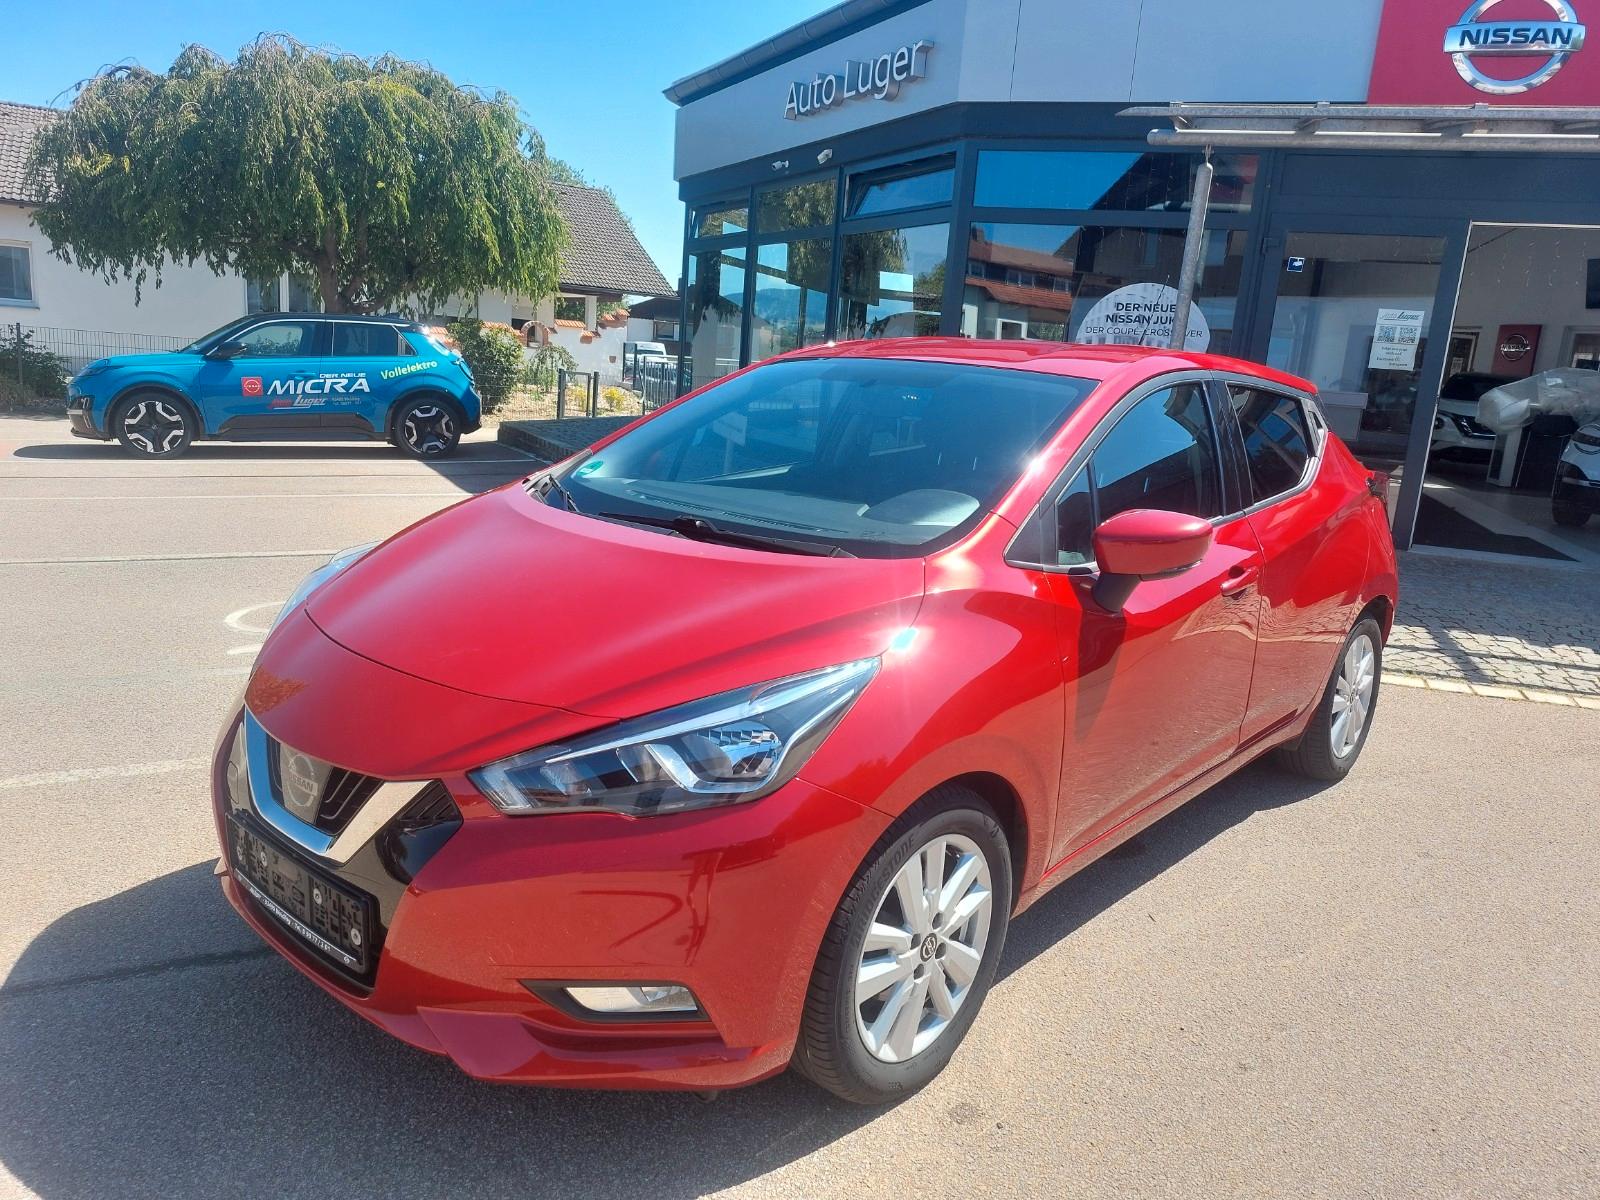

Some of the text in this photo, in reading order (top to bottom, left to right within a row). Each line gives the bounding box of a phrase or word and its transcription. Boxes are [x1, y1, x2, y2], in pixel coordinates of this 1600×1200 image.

[1459, 27, 1573, 46] NISSAN
[784, 40, 931, 119] Auto Luger
[1115, 303, 1177, 313] DER NEUE
[1105, 314, 1175, 325] NISSAN JUK
[1085, 326, 1104, 334] DER
[381, 361, 438, 380] Vollelektro
[267, 378, 371, 395] MICRA
[293, 395, 327, 408] Luger
